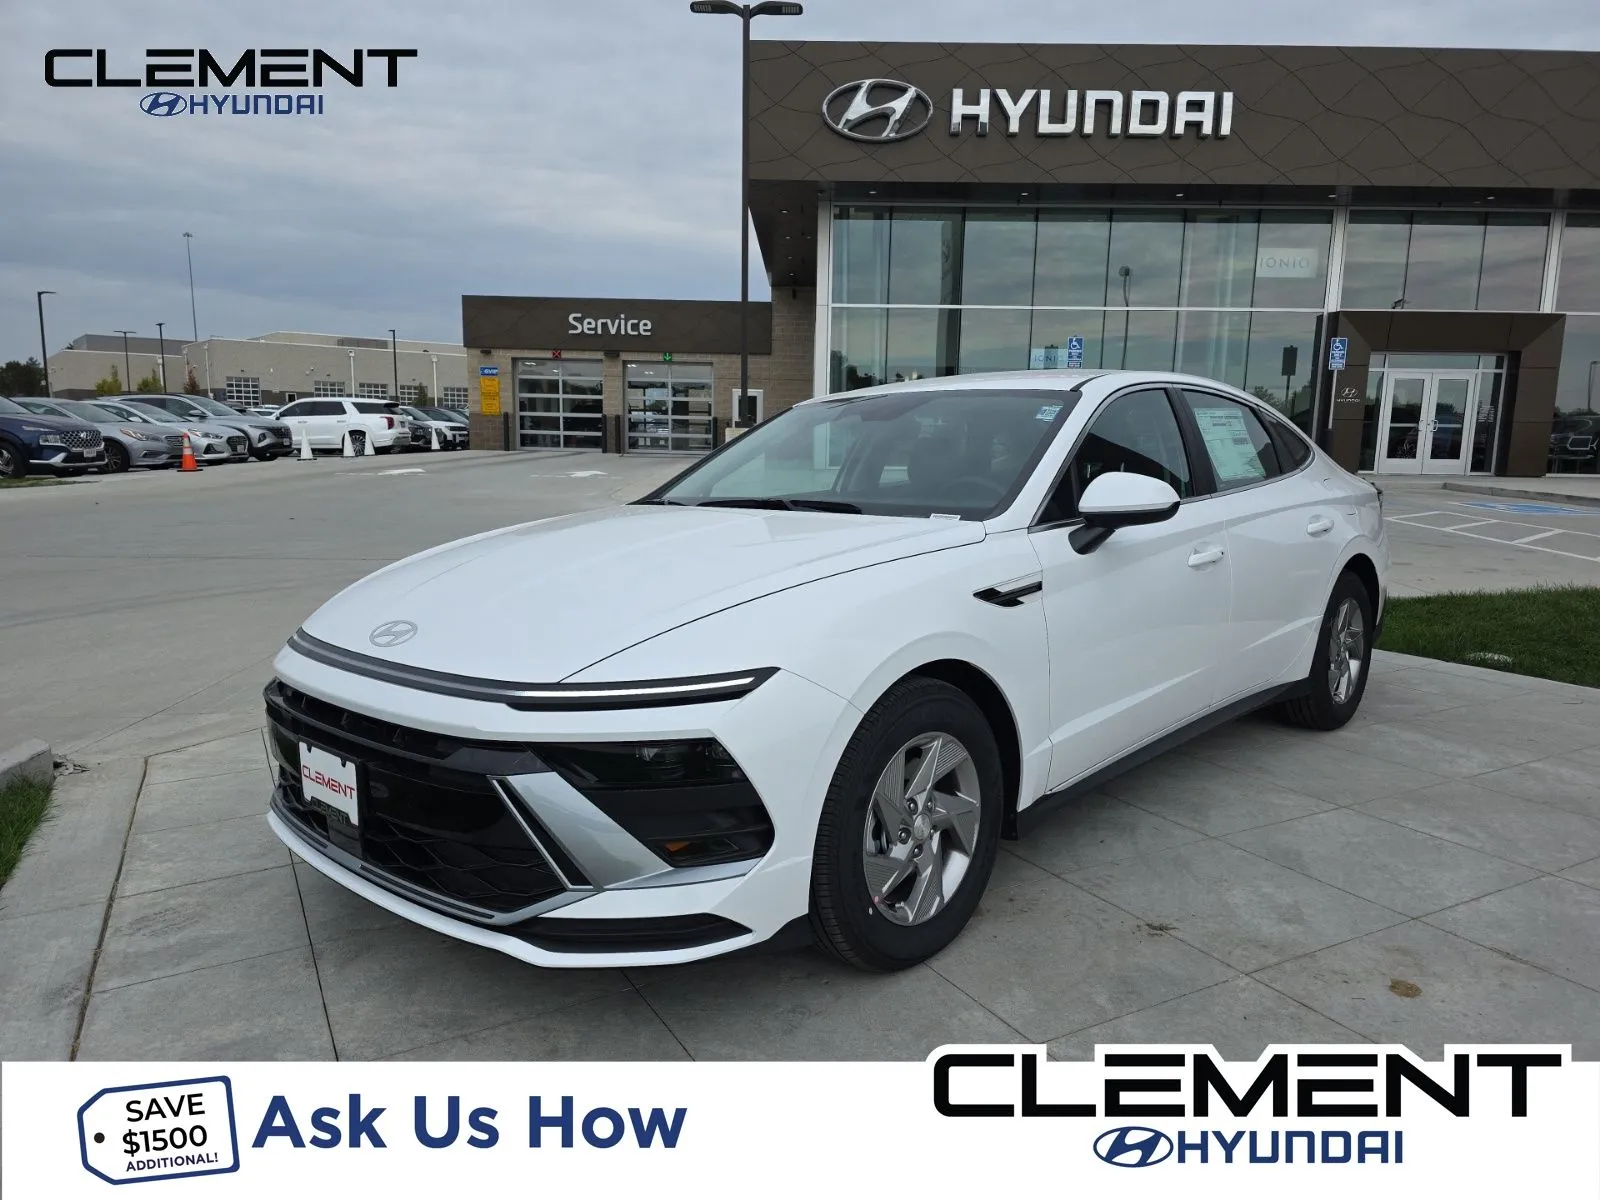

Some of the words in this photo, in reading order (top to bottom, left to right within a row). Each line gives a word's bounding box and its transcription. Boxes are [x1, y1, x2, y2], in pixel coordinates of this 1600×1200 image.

[949, 88, 1234, 138] HYUNDAI
[568, 312, 652, 336] Service
[302, 764, 355, 800] CLEMENT
